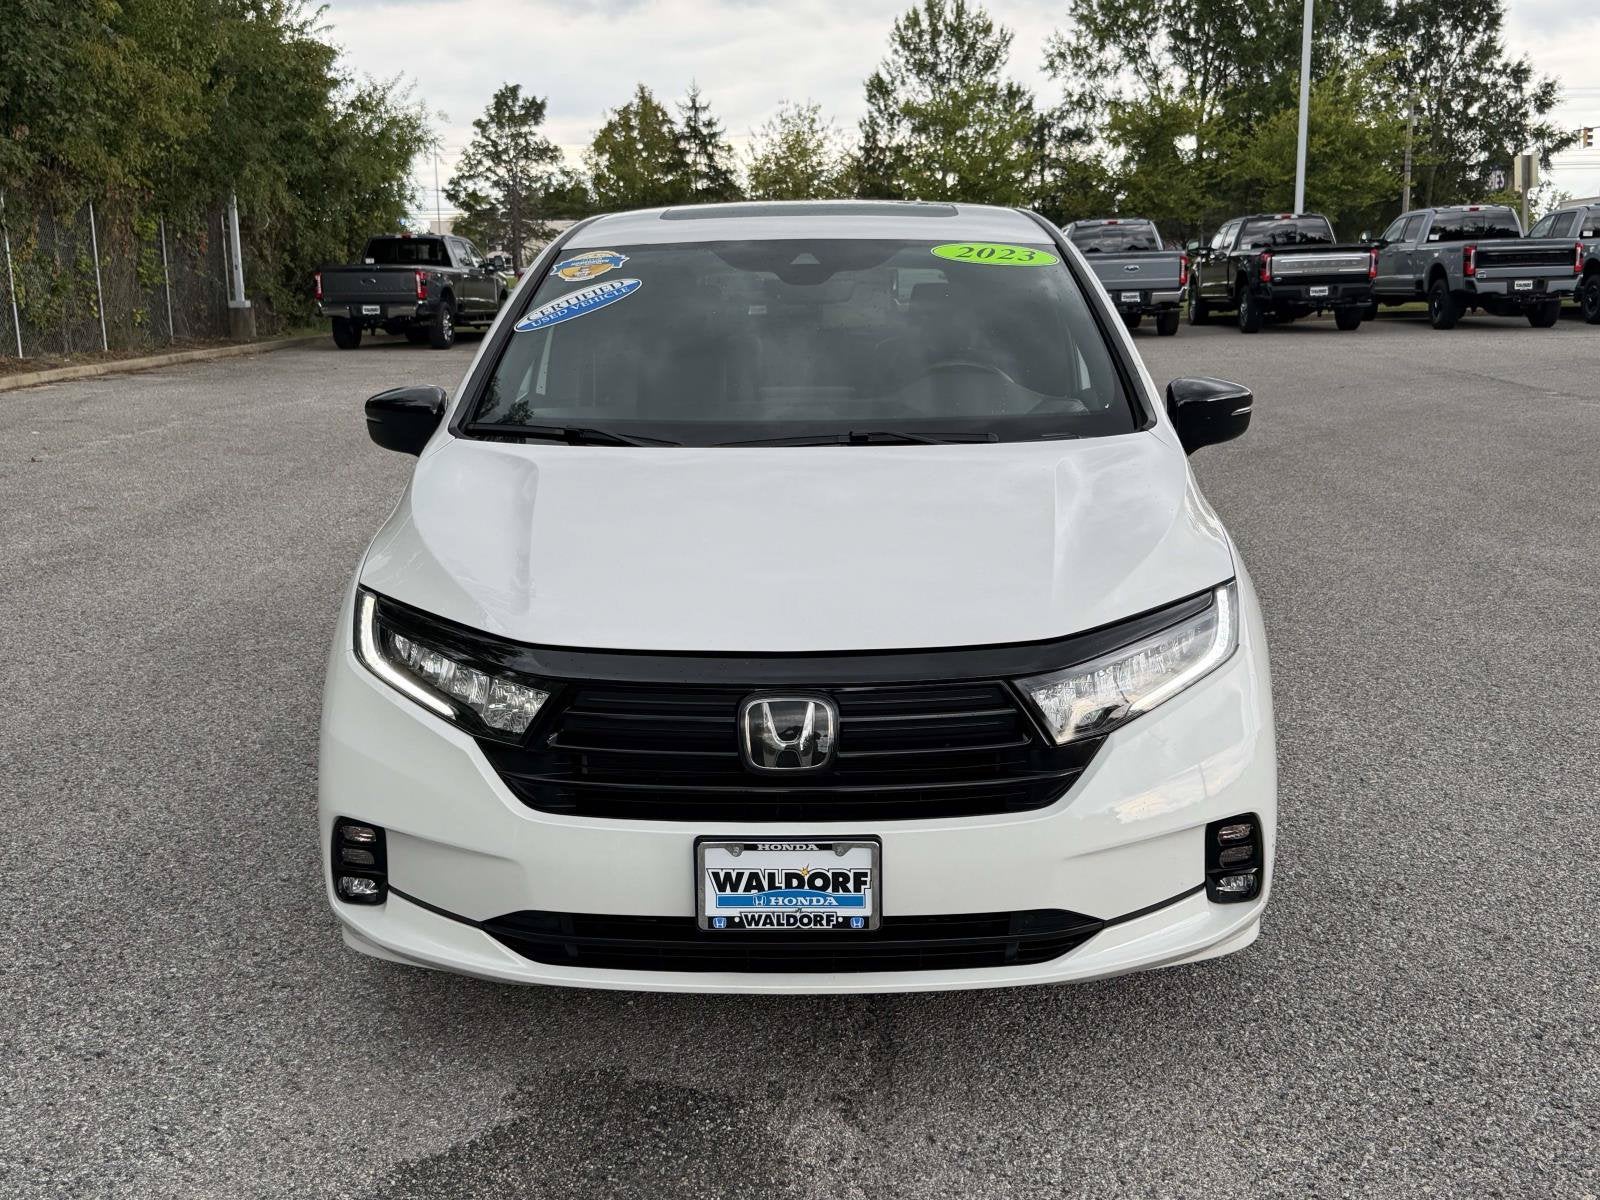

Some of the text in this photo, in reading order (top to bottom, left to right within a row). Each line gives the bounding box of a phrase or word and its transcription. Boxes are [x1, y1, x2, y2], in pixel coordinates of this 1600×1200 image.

[956, 246, 1036, 261] 2023
[526, 281, 625, 321] CERTIFIED
[531, 286, 630, 327] USED VEHICLE
[756, 843, 819, 851] HONDA
[710, 870, 869, 893] WALDORF
[769, 896, 839, 906] HONDA
[742, 914, 836, 928] WALDORF
